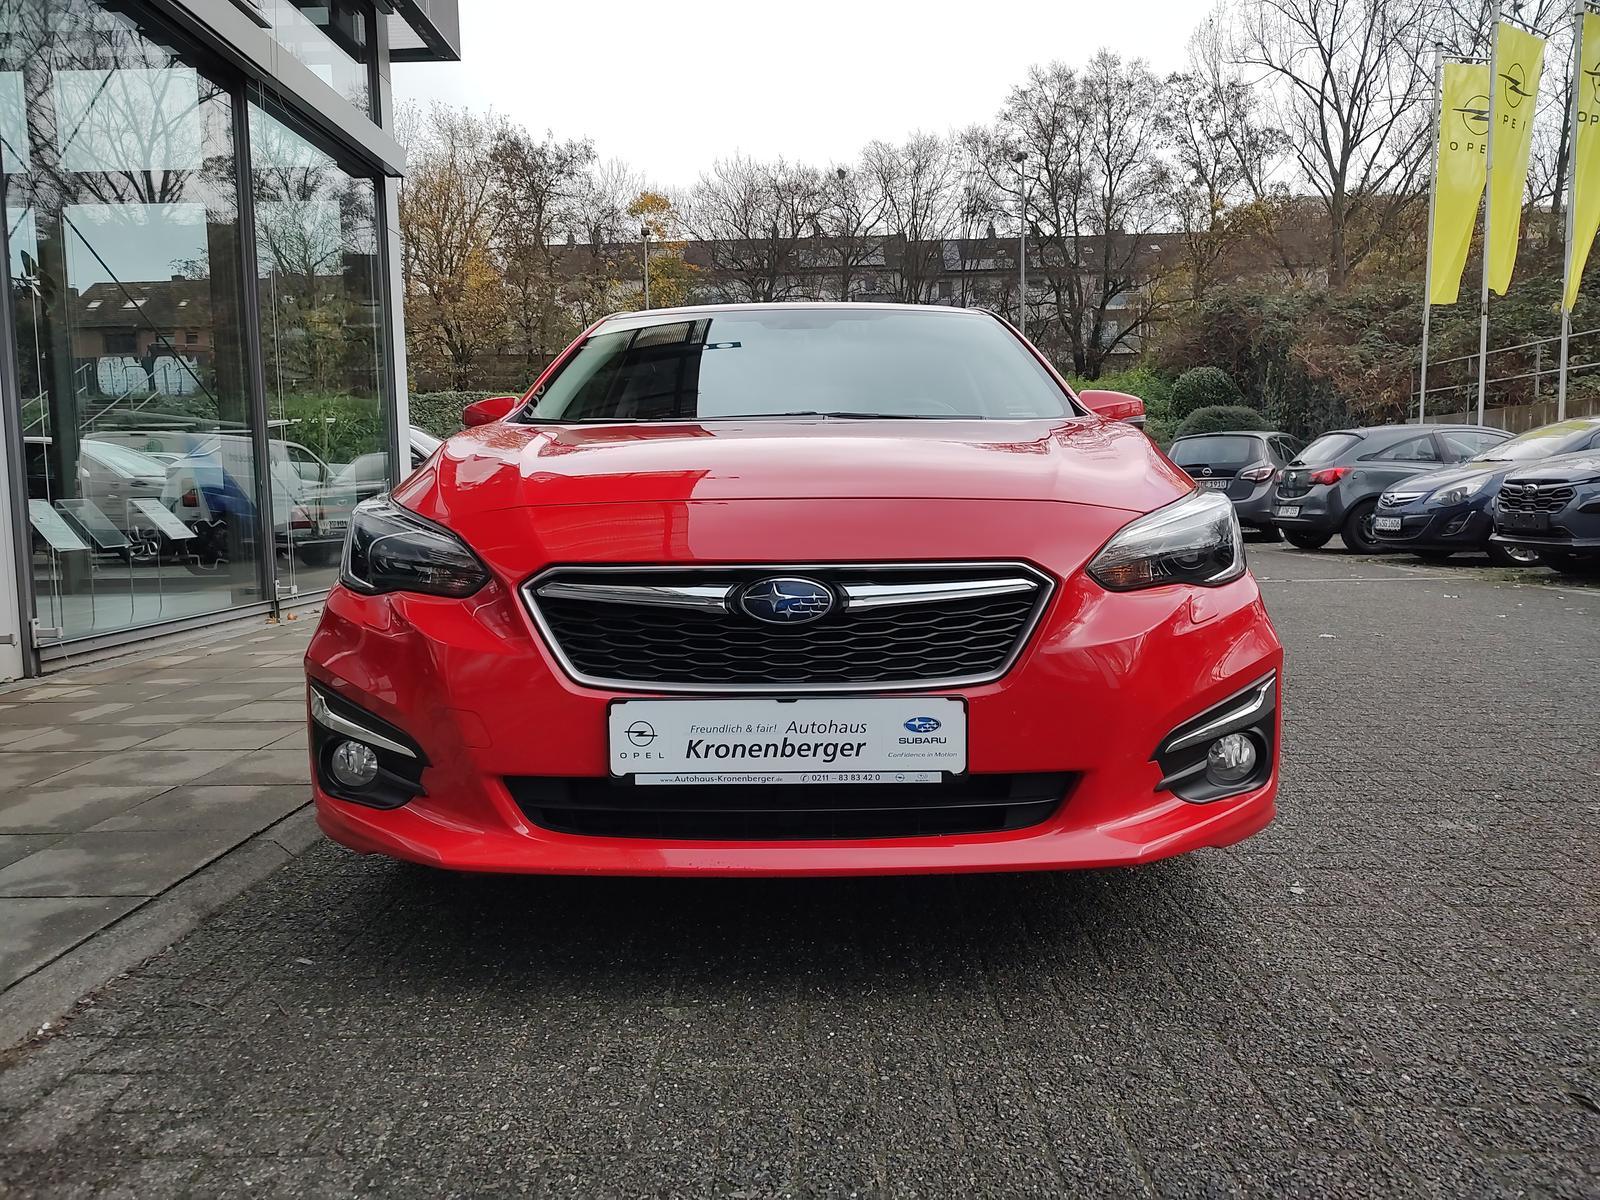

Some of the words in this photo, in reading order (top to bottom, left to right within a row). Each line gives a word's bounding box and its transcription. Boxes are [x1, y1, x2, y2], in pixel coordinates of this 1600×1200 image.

[690, 724, 742, 734] Freundlich
[745, 724, 753, 733] &
[756, 723, 777, 733] fair!
[785, 719, 867, 734] Autohaus
[898, 736, 947, 744] SUBARU
[685, 736, 867, 763] Kronenberger
[619, 752, 665, 760] OPEL
[811, 774, 829, 782] 0211
[850, 773, 861, 781] 83
[862, 773, 873, 781] 42
[875, 773, 881, 781] 0
